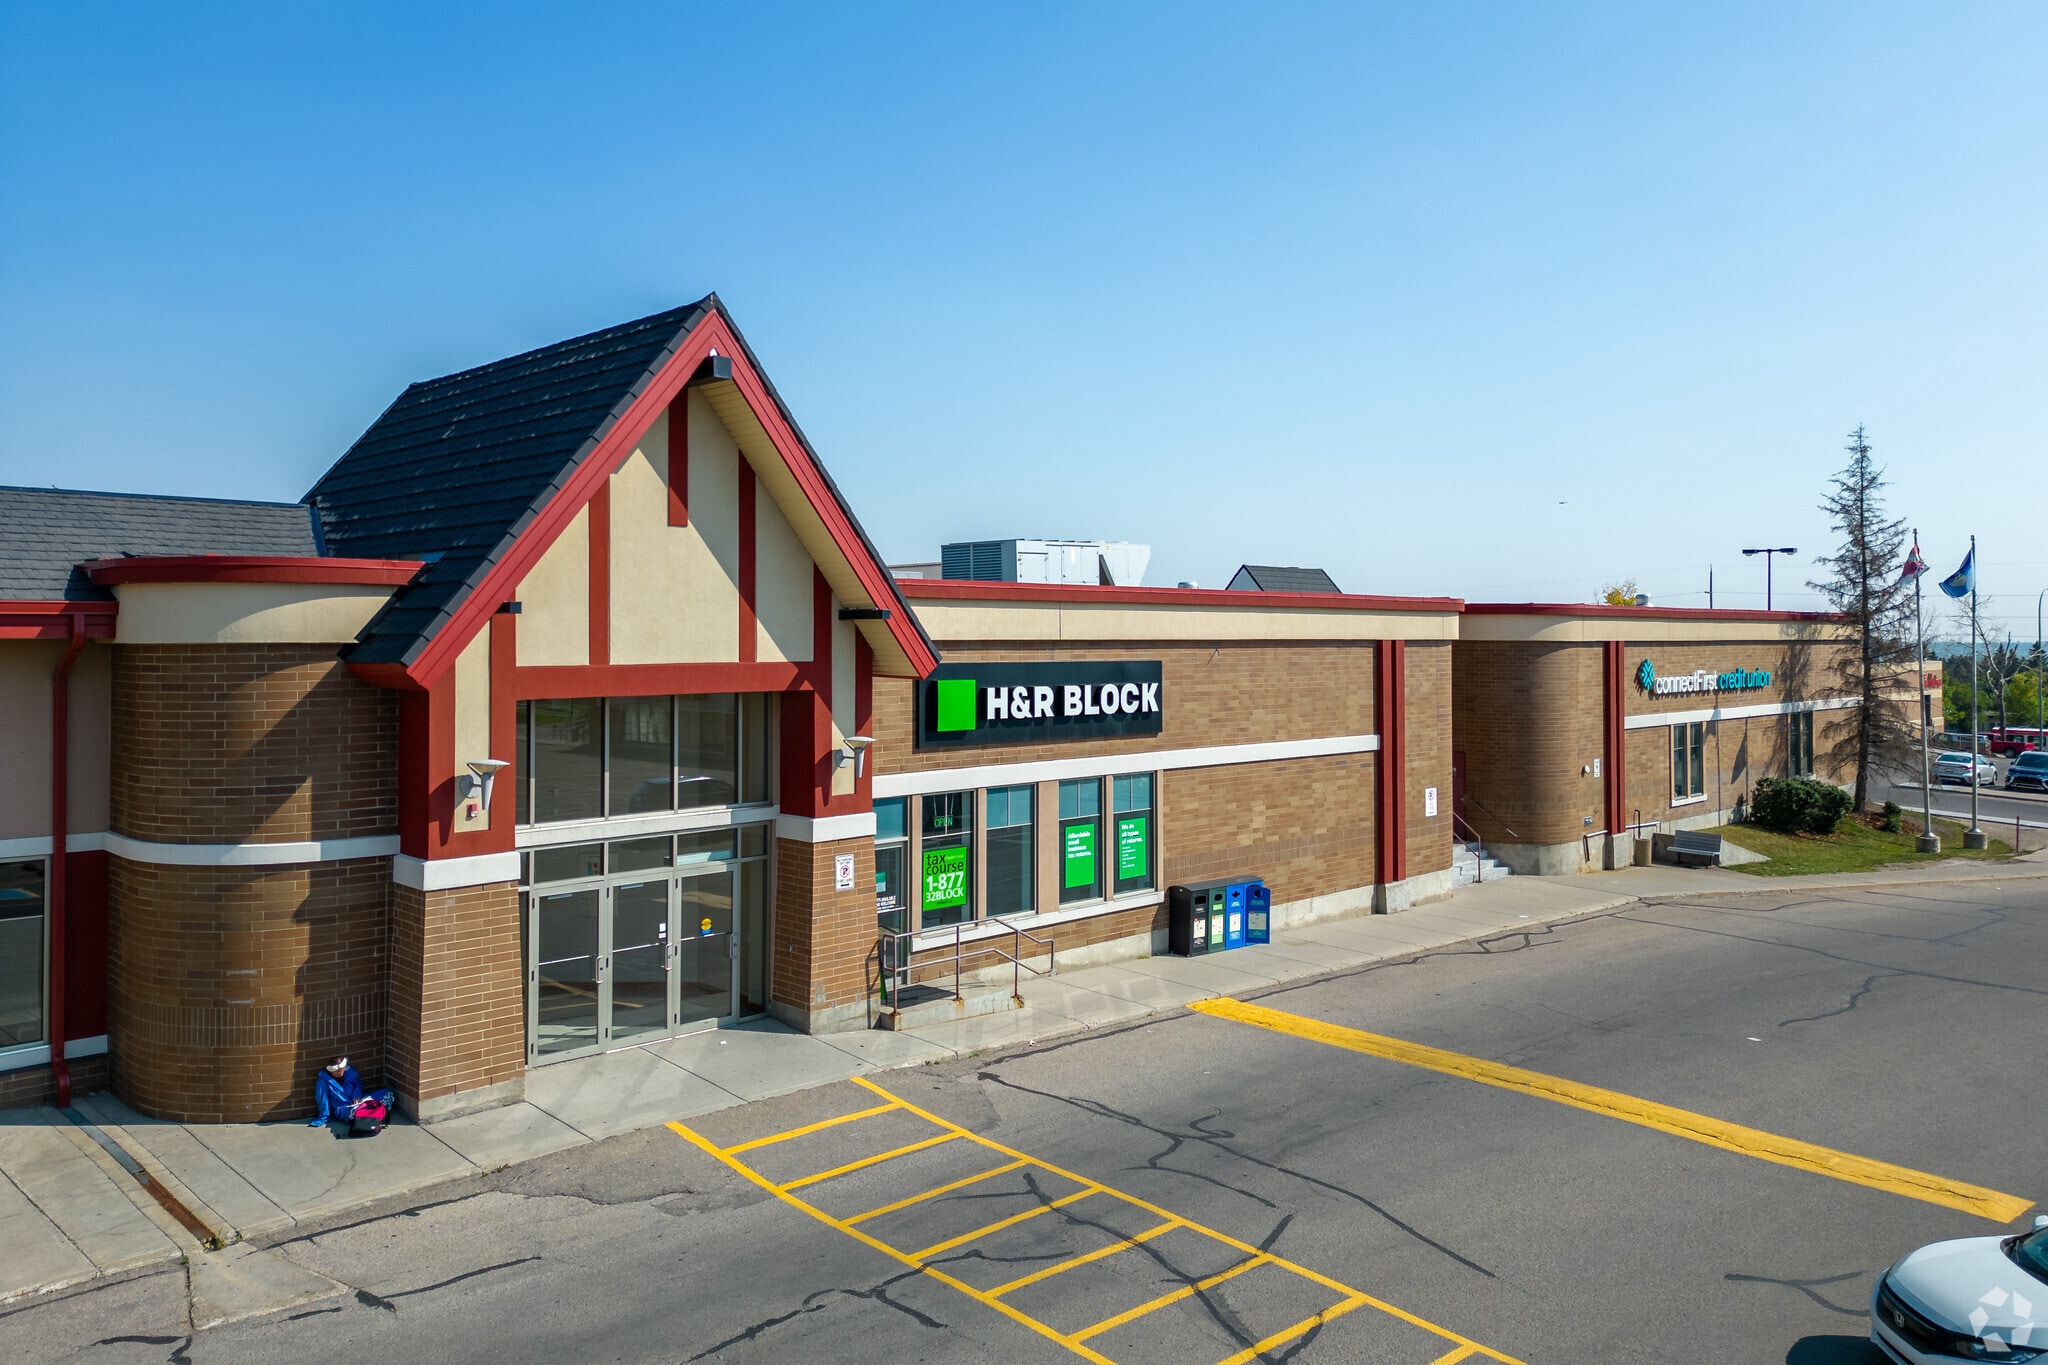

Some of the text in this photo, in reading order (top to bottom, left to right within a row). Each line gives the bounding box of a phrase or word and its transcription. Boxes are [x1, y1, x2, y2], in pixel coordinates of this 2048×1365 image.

[1655, 667, 1771, 694] connectFirst credit union
[987, 682, 1160, 720] H&R BLOCK
[934, 817, 953, 828] OPEN
[926, 854, 946, 866] tax
[926, 861, 964, 876] course
[926, 871, 964, 892] 1-877
[925, 887, 964, 903] 32BLOCK
